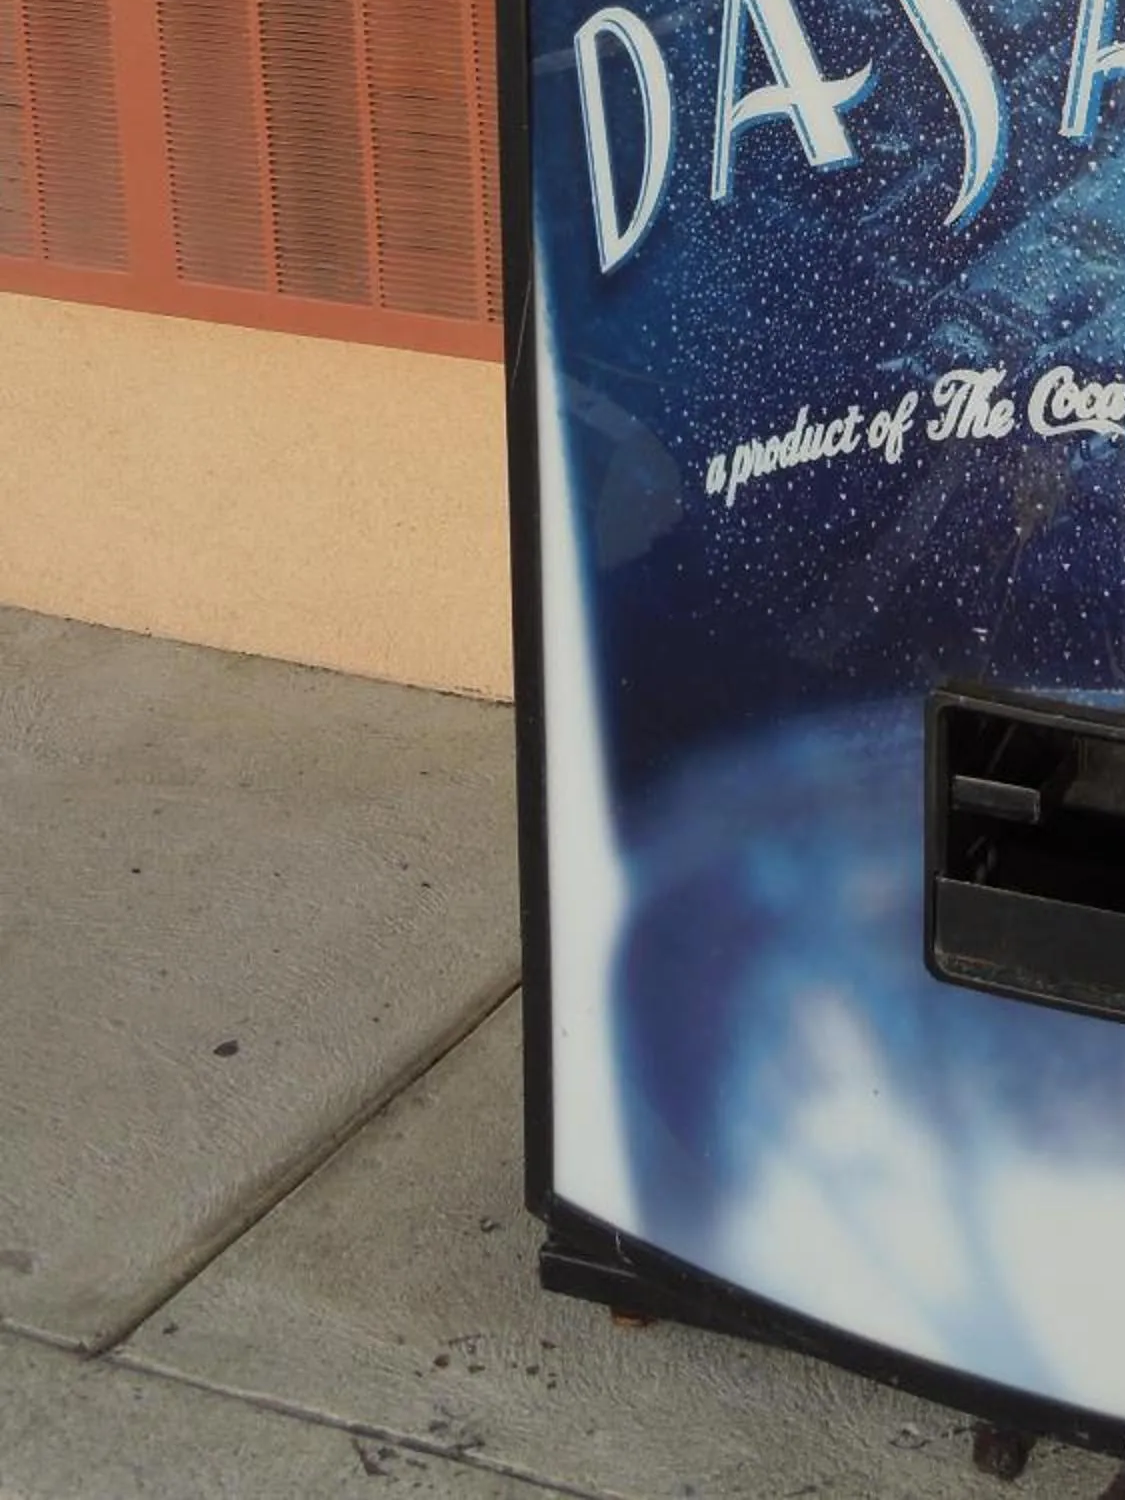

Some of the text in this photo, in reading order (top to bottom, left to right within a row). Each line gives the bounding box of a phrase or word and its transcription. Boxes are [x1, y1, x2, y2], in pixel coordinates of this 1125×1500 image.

[703, 455, 726, 495] a
[726, 404, 863, 506] product
[867, 390, 918, 465] of
[928, 367, 1014, 443] The
